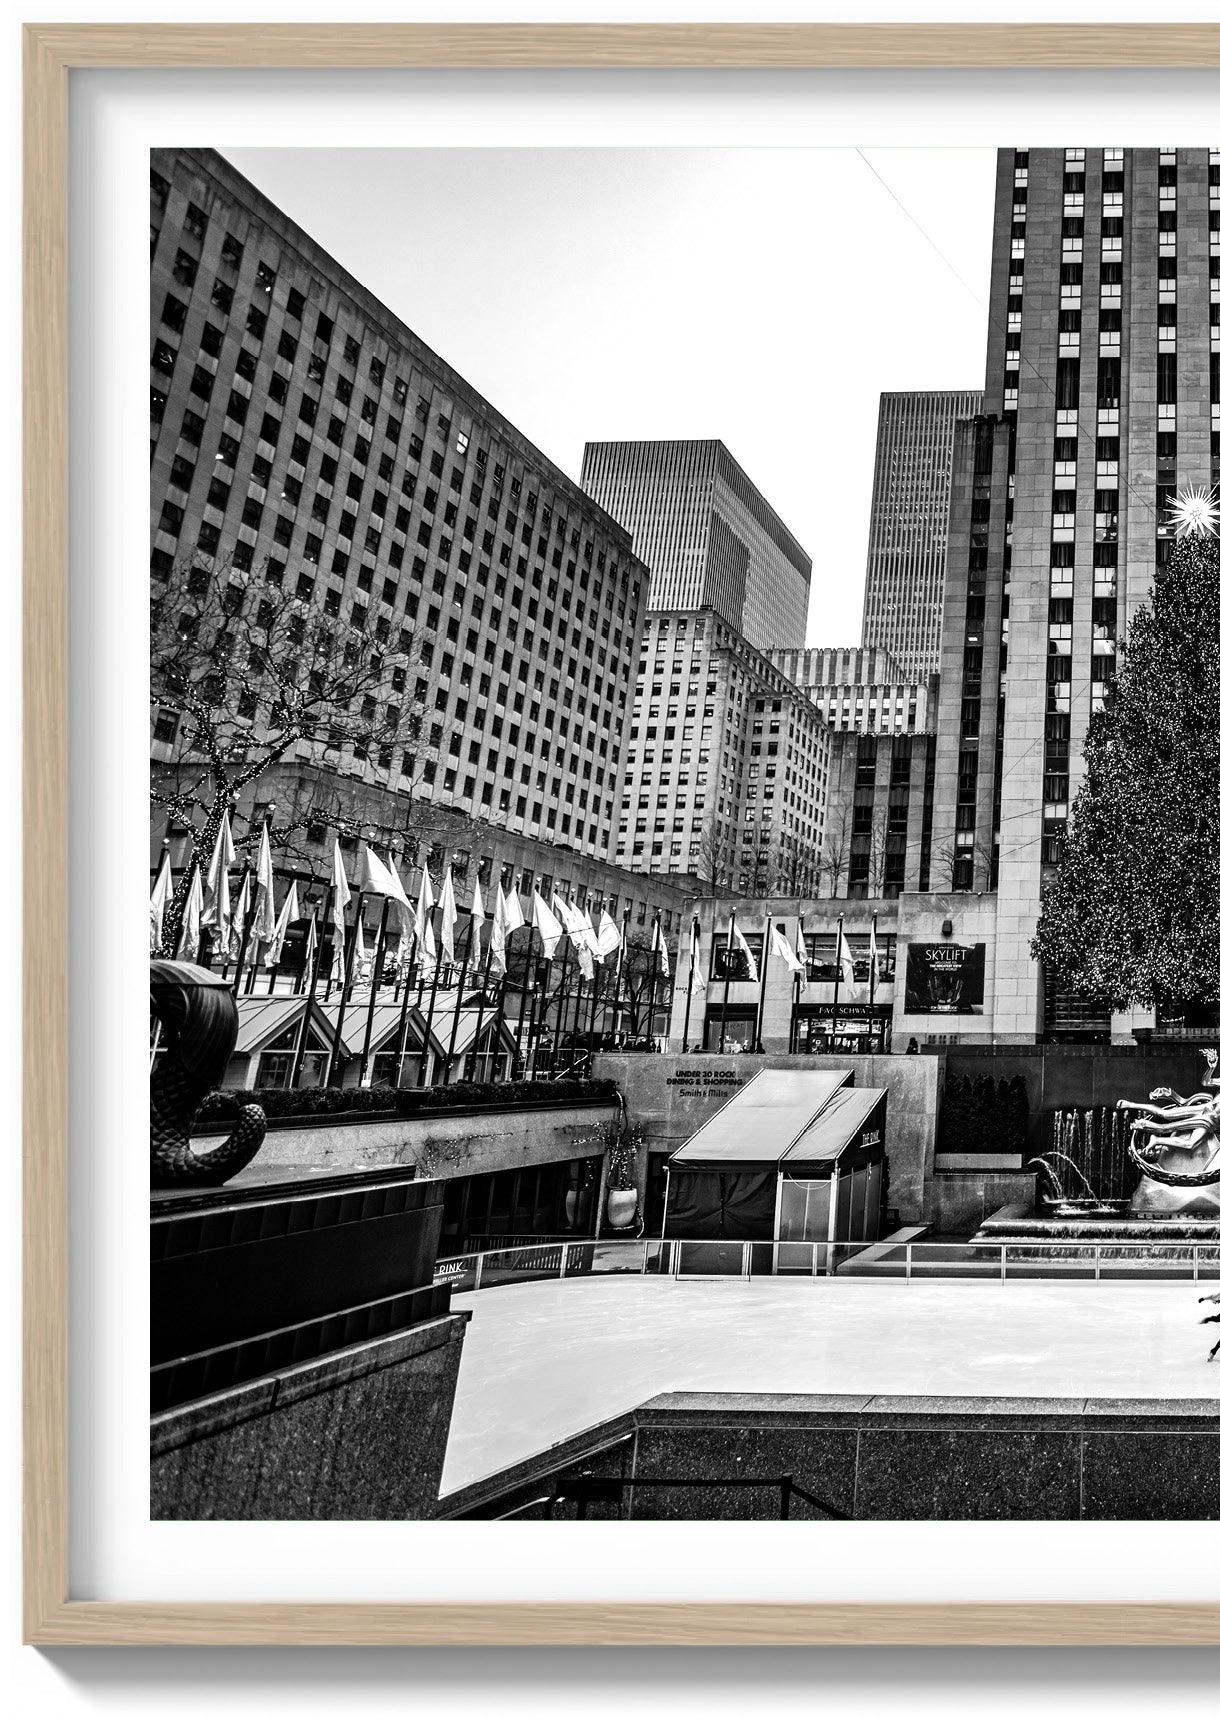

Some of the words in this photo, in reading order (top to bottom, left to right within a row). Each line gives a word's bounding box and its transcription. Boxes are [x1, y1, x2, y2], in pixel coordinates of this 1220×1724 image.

[925, 949, 967, 961] SKYLIFT
[675, 1070, 701, 1078] UNDER
[702, 1070, 713, 1078] 30
[713, 1070, 736, 1078] ROCK
[666, 1078, 695, 1086] DINING
[695, 1078, 702, 1086] &
[703, 1078, 743, 1086] SHOPPING
[679, 1089, 701, 1098] Smith
[708, 1089, 728, 1098] Mills
[440, 1262, 463, 1274] RINK
